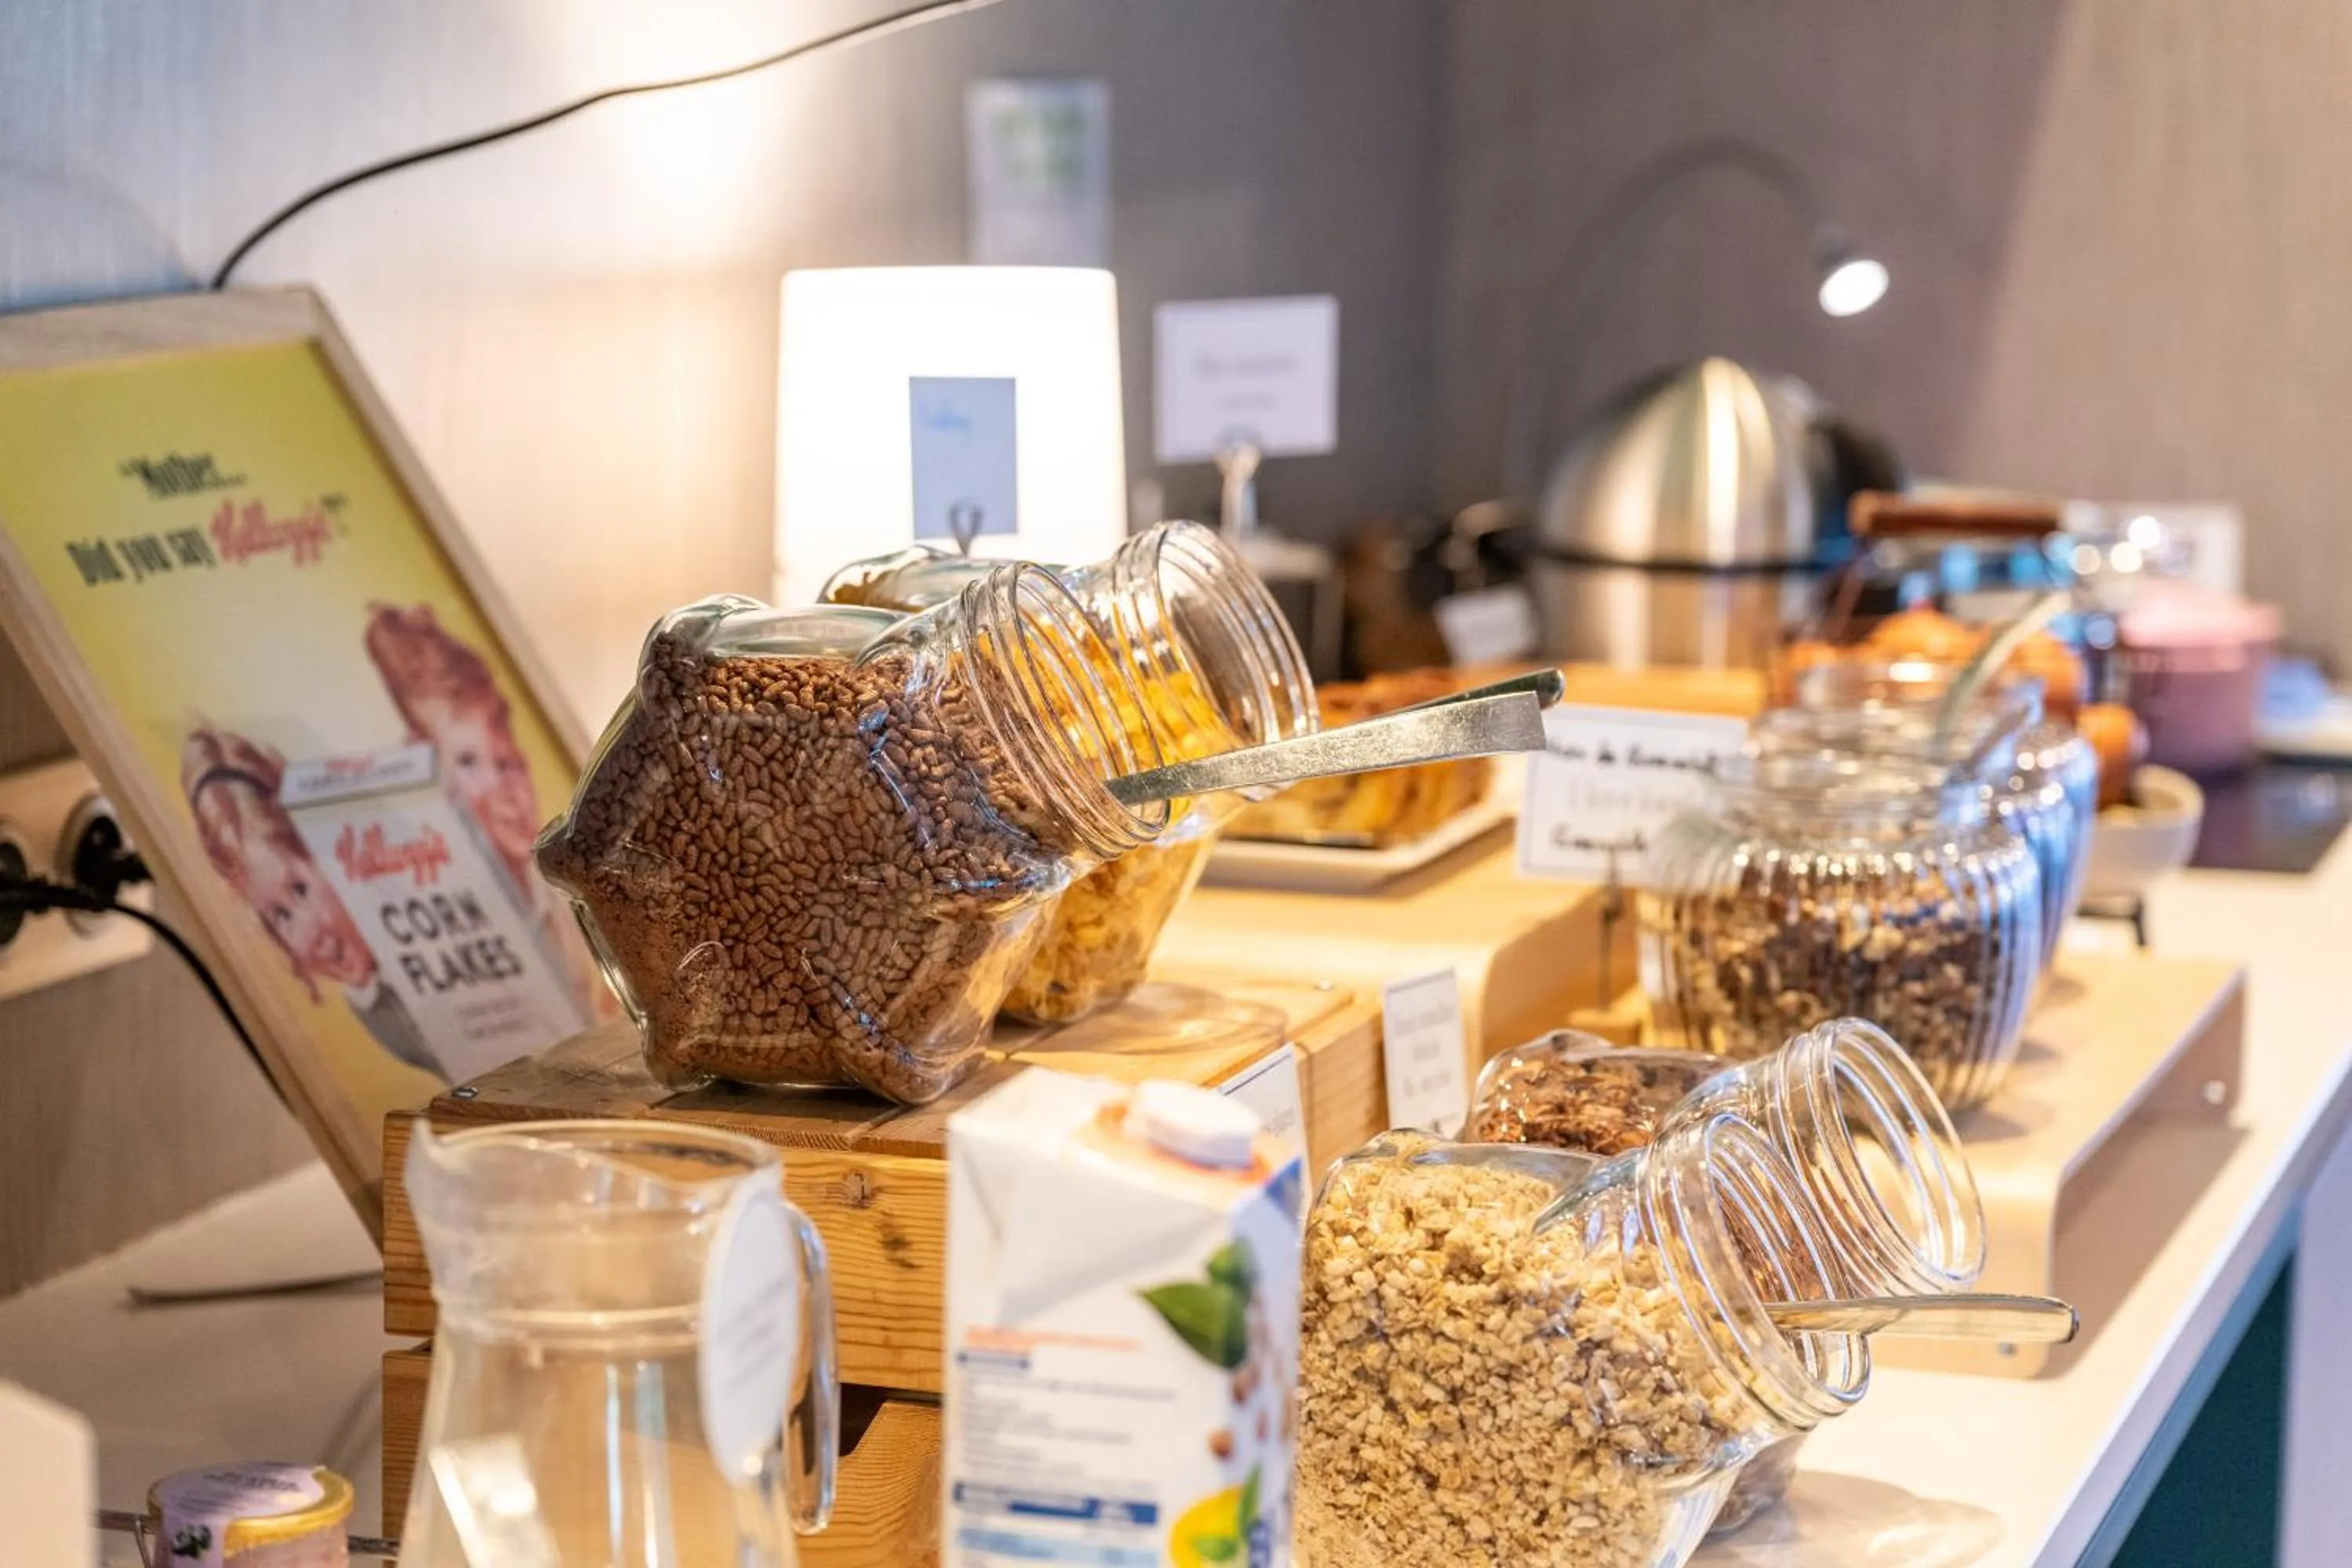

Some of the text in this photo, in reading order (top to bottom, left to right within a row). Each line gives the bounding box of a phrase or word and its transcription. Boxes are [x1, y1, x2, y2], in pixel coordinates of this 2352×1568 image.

[118, 536, 171, 581] you
[380, 890, 488, 946] CORN
[399, 936, 523, 993] FLAKES
